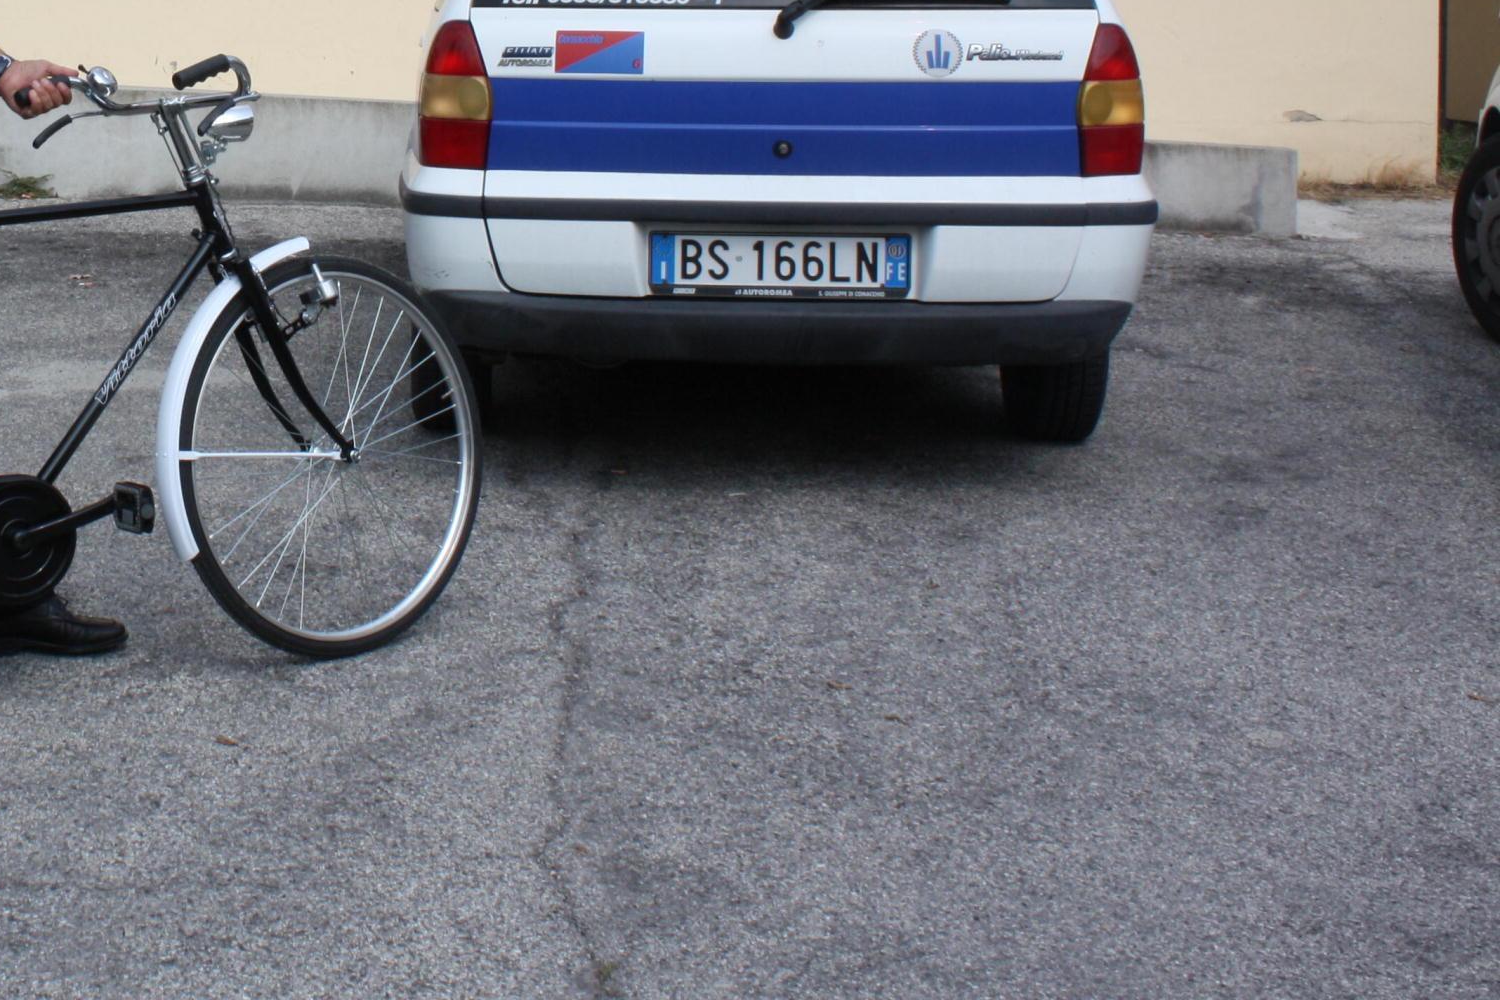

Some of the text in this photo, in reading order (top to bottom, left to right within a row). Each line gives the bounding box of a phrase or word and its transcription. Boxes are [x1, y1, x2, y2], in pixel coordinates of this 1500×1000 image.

[966, 43, 1011, 61] Palio
[681, 239, 730, 280] BS
[752, 240, 878, 282] 166LN
[886, 261, 907, 281] FE
